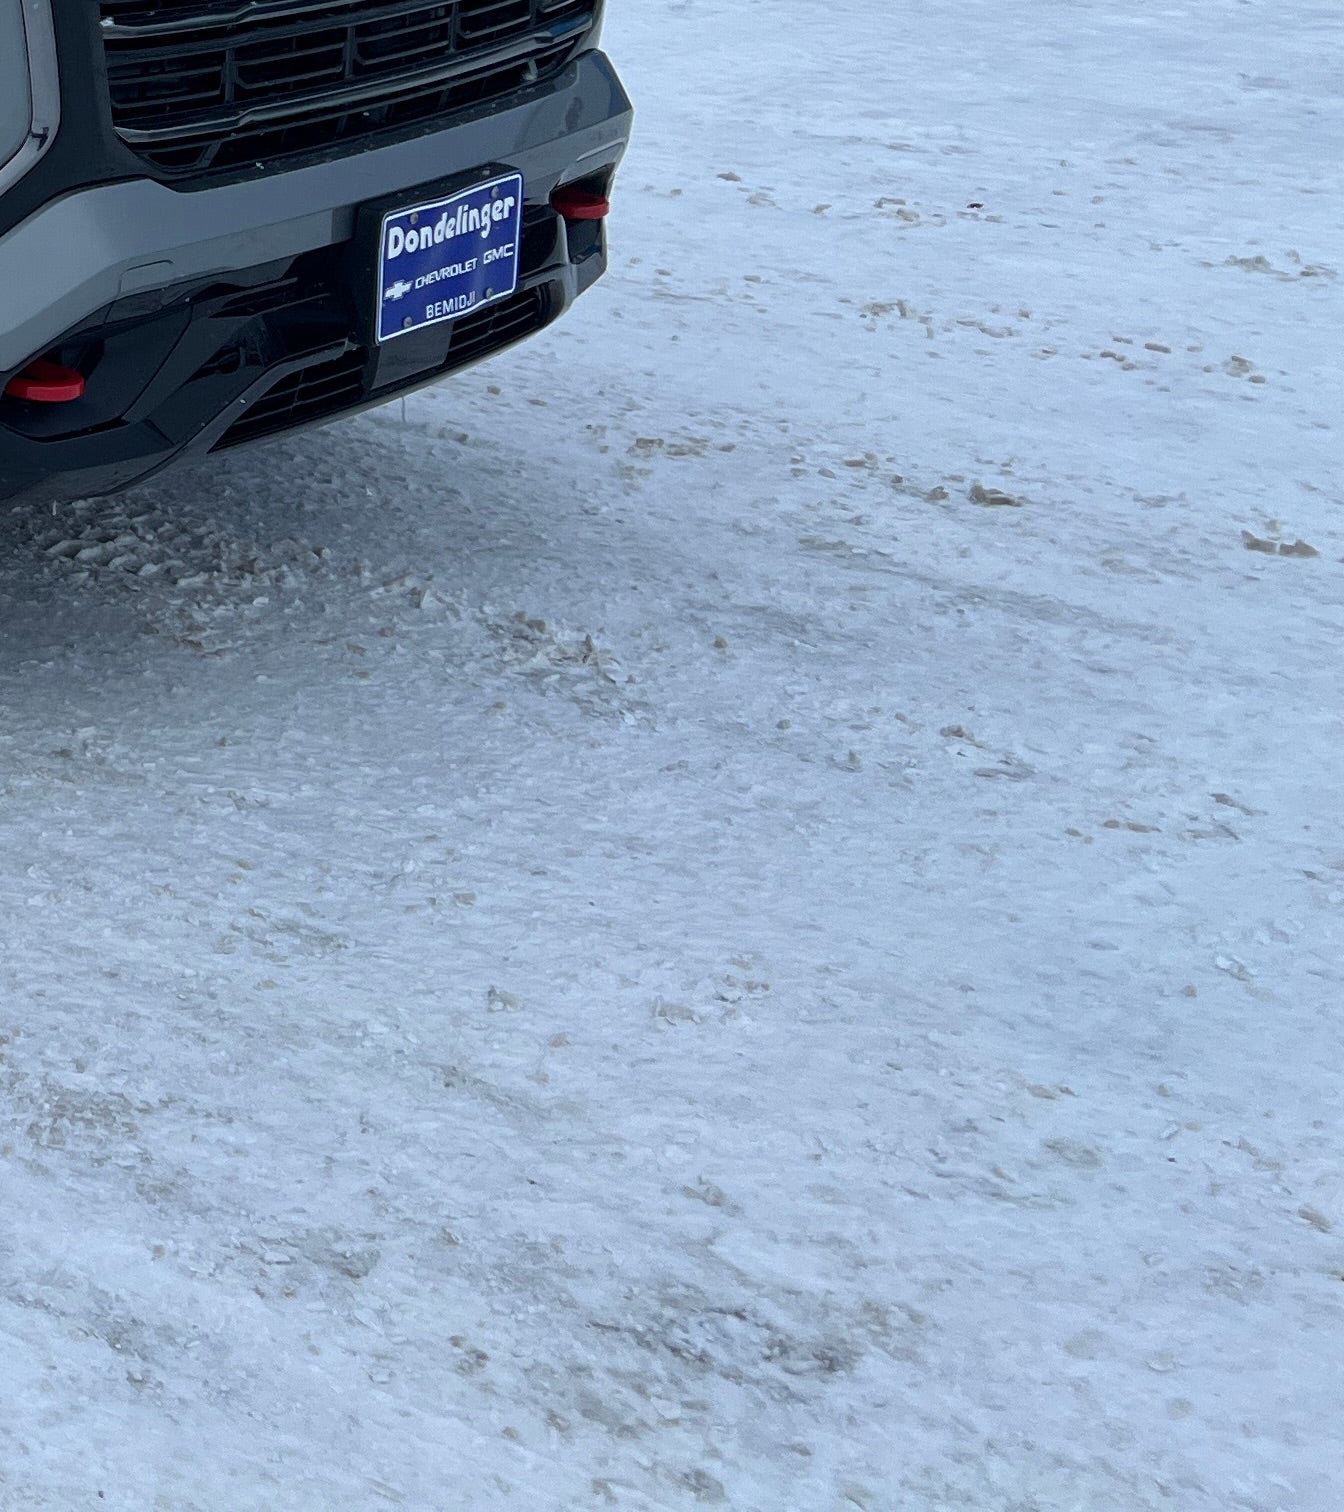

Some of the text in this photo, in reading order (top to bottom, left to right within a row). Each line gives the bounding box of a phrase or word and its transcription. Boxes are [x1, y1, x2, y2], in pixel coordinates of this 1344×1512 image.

[387, 196, 515, 260] Dondelinger
[415, 243, 514, 290] CHEVROLET GMC
[426, 291, 476, 319] BEMIDJI
